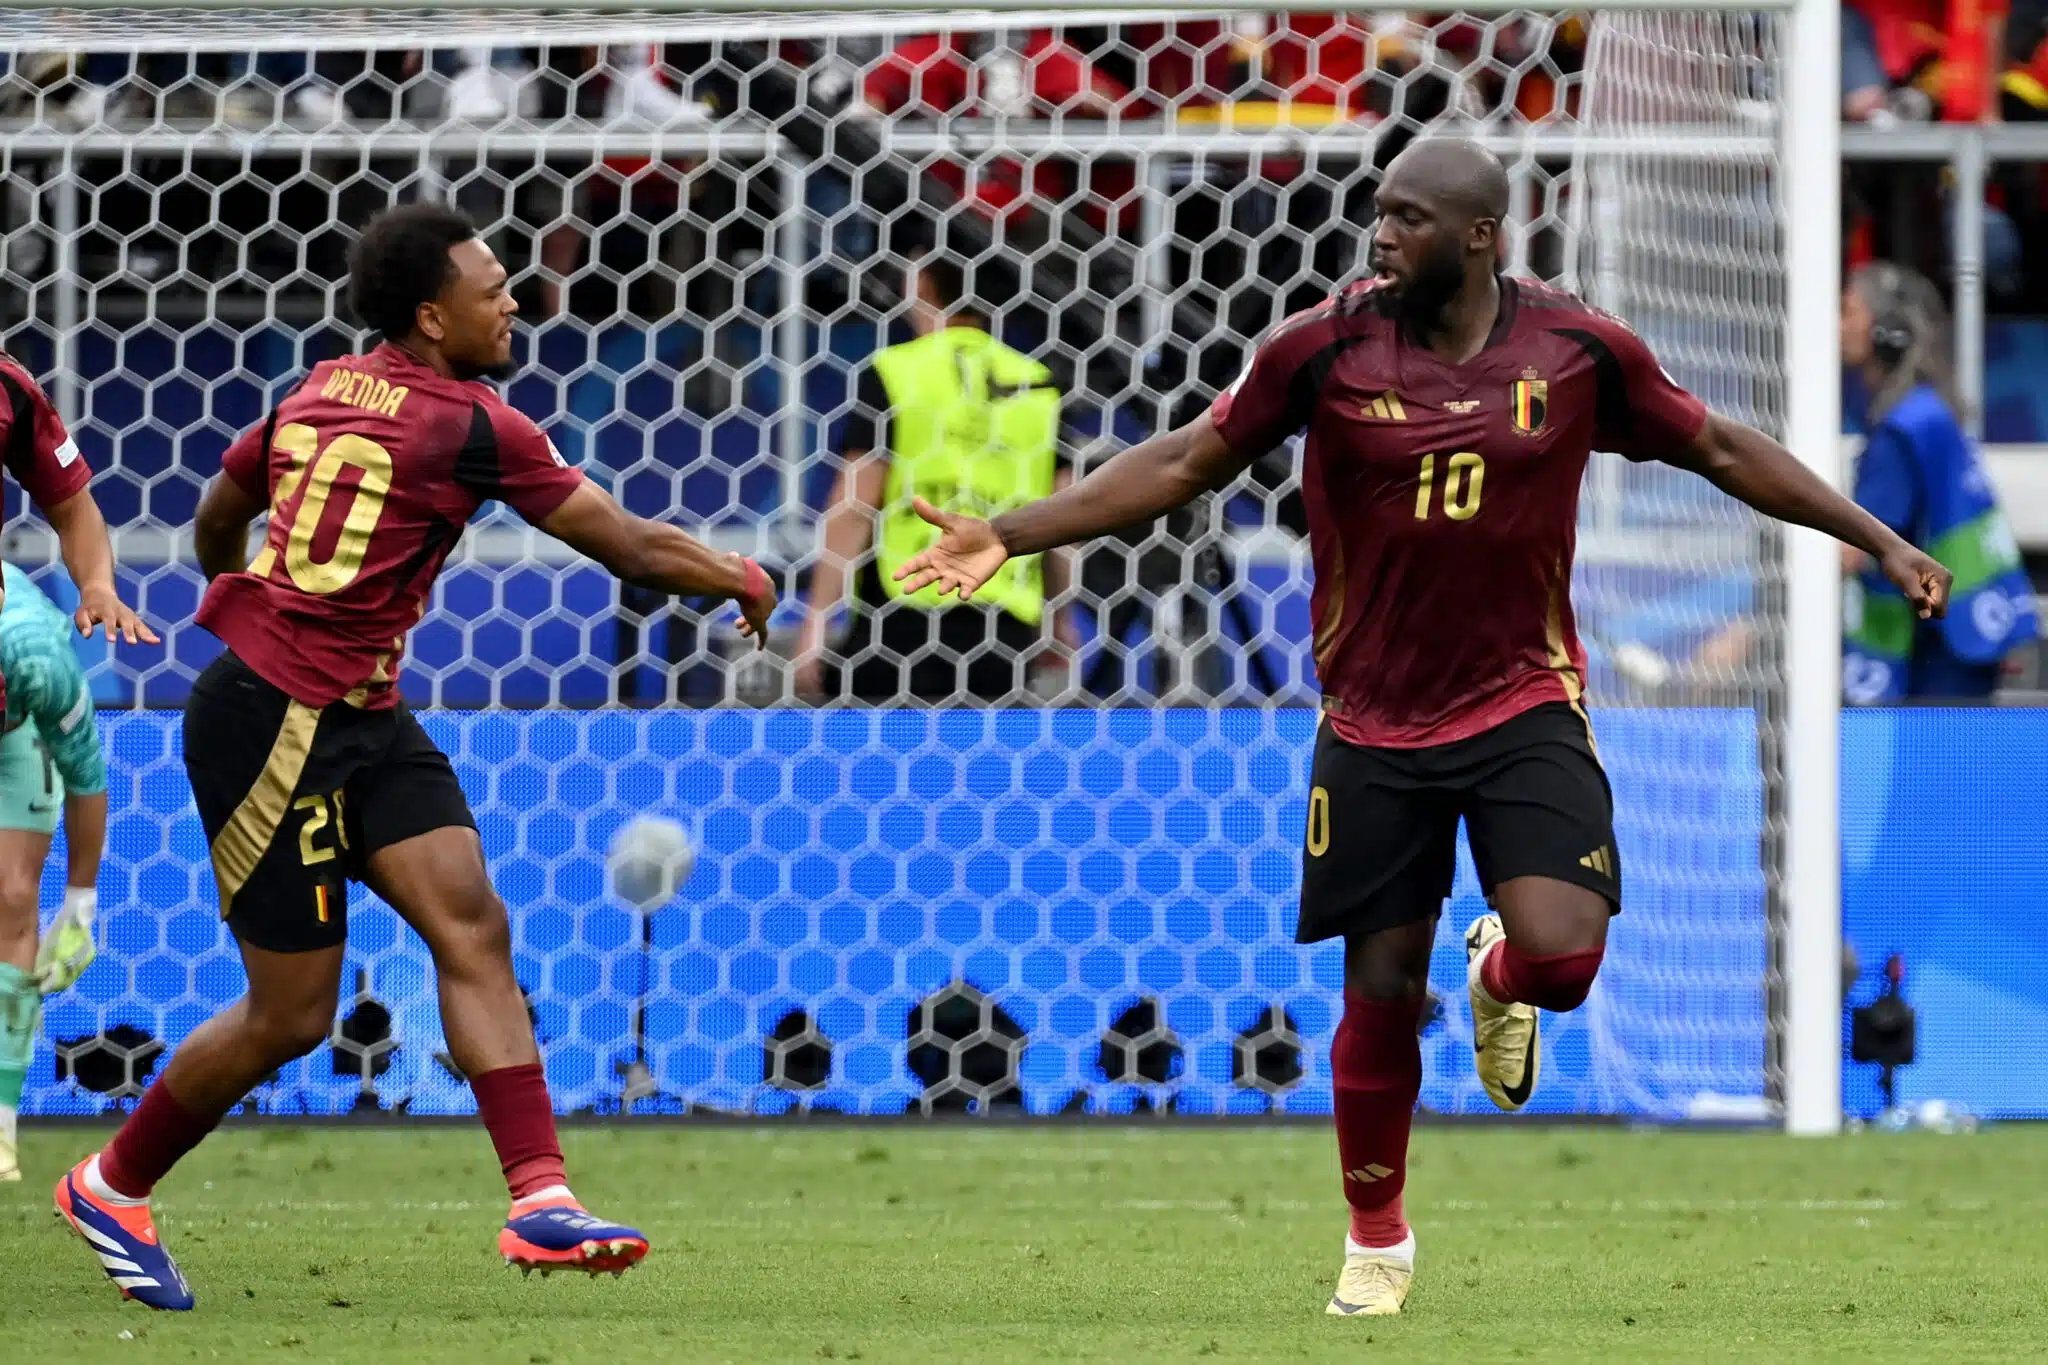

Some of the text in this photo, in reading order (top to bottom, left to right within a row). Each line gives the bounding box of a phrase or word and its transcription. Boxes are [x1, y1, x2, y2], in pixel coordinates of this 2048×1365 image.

[320, 367, 409, 417] OPENDA
[247, 422, 392, 594] 20
[1414, 452, 1485, 520] 10
